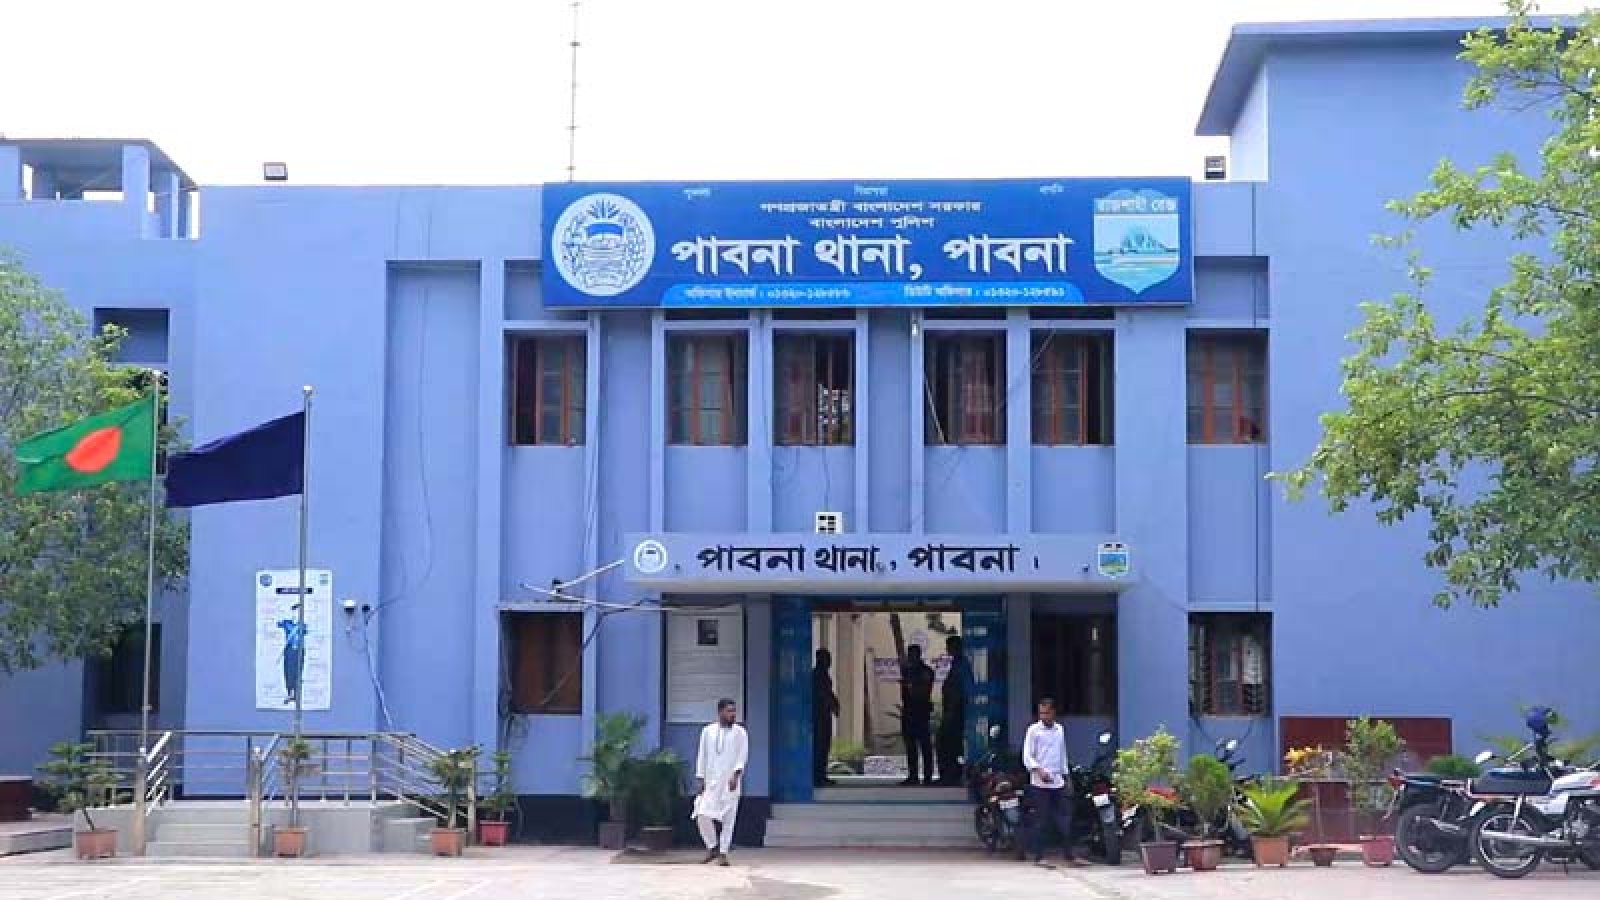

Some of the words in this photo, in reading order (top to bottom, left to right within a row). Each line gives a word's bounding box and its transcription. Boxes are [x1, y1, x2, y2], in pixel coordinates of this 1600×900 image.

[671, 234, 801, 275] পাবনা
[813, 233, 923, 281] থানা,
[943, 232, 1075, 273] পাবনা
[697, 545, 806, 572] পাবনা
[907, 544, 1021, 572] পাবনা
